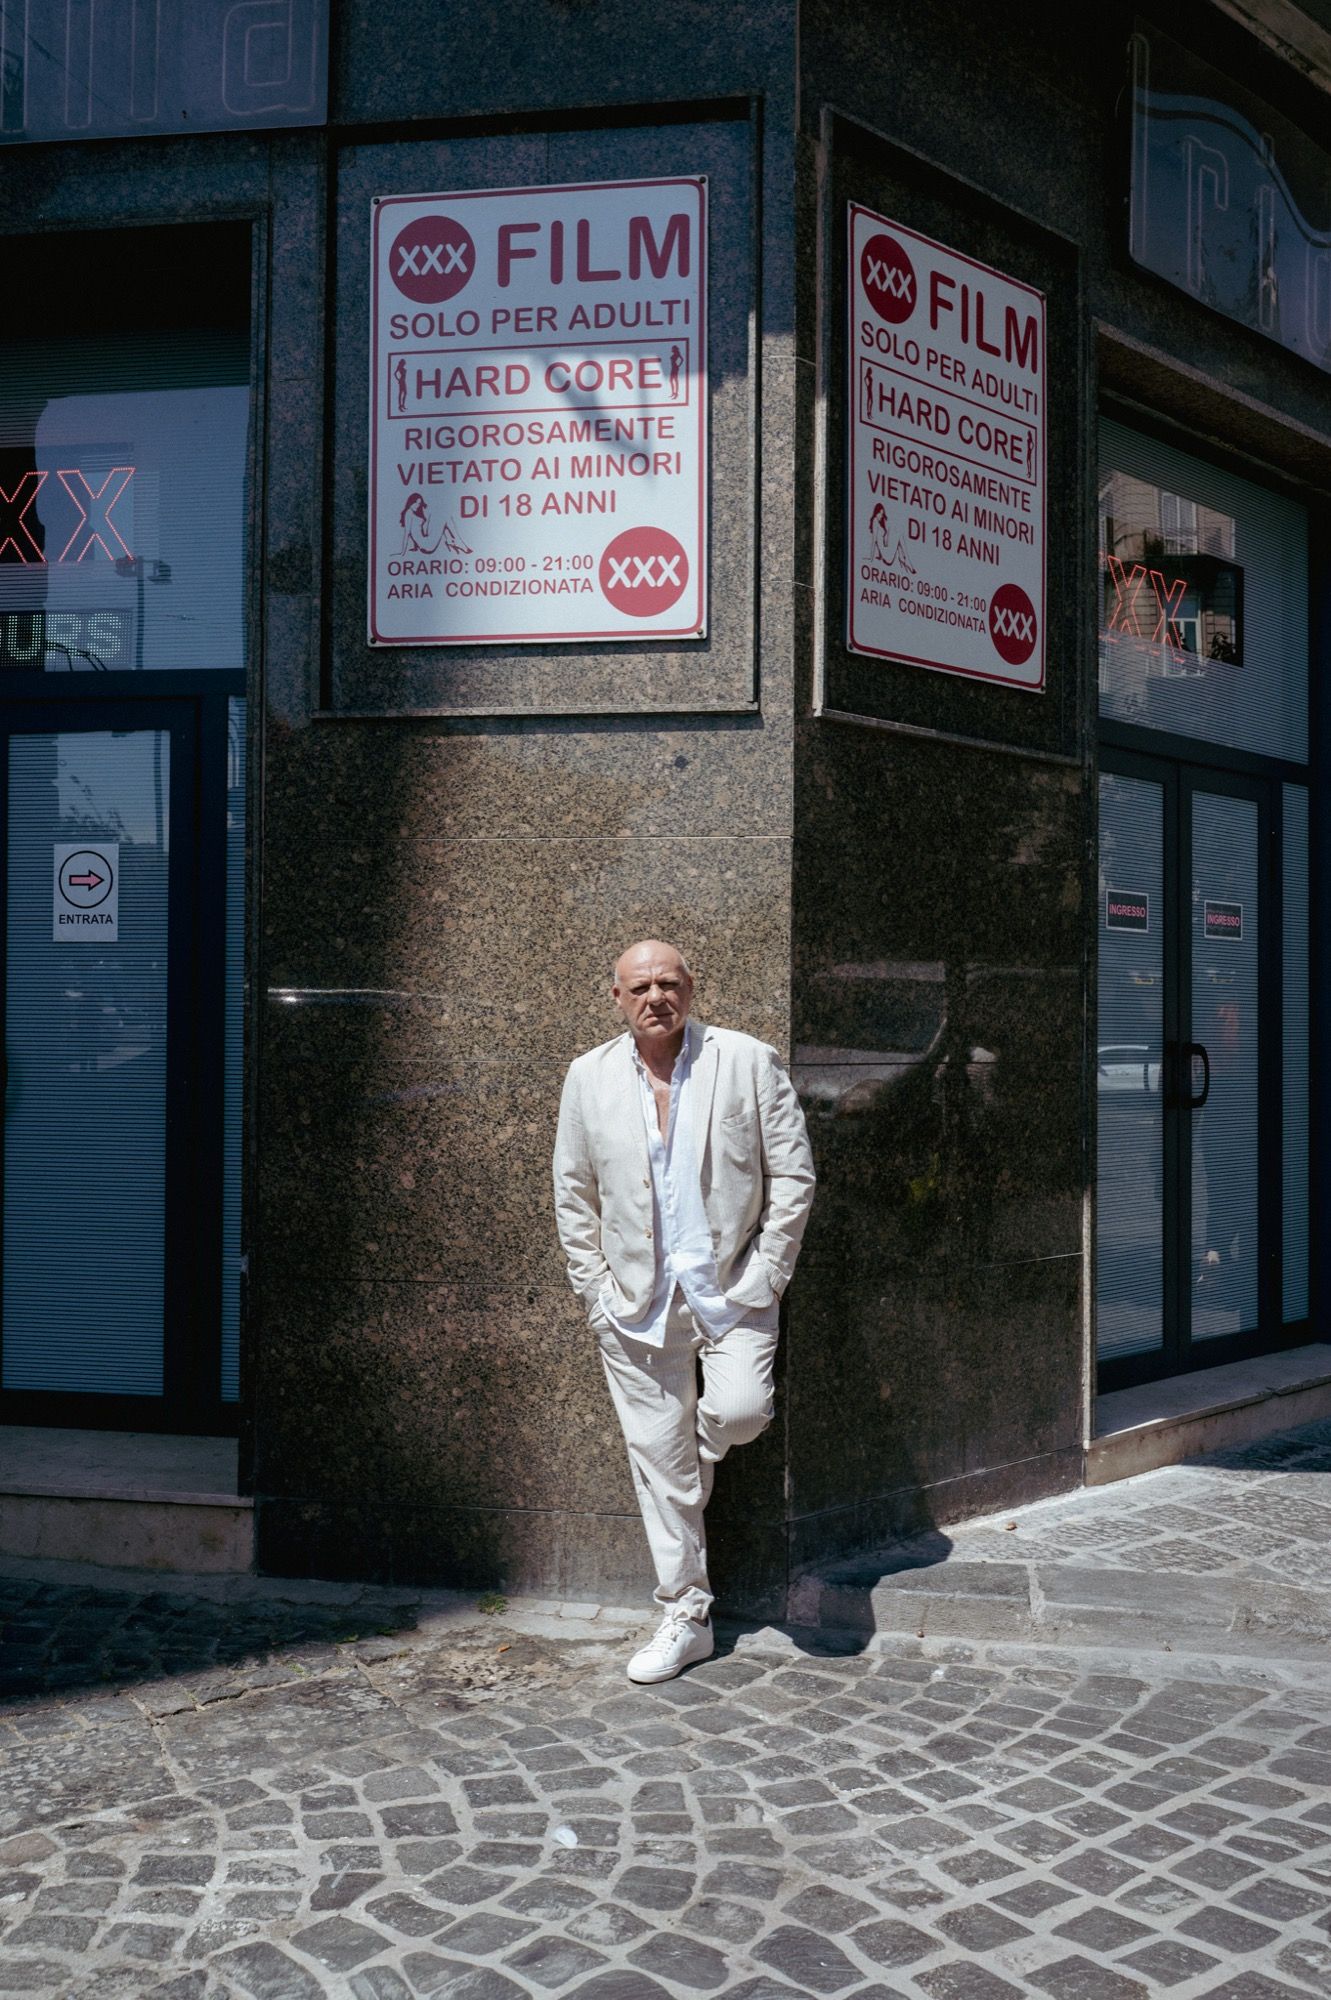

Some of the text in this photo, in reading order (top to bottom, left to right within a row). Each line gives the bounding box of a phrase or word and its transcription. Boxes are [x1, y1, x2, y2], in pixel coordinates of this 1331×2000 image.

[398, 242, 468, 277] XXX
[498, 213, 690, 288] FILM
[866, 255, 913, 304] XXX
[389, 299, 690, 340] SOLO PER ADULTI
[930, 270, 1037, 374] FILM
[416, 357, 662, 400] HARD CORE
[861, 320, 1038, 416] SOLO PER ADULTI
[405, 416, 675, 450] RIGOROSAMENTE
[879, 382, 1023, 465] HARD CORE
[397, 452, 681, 486] VIETATO AI MINORI
[873, 437, 1031, 513] RIGOROSAMENTE
[460, 490, 616, 519] DI 18 ANNI
[867, 469, 1034, 545] VIETATO AI MINORI
[908, 518, 999, 566] DI 18 ANNI
[388, 558, 469, 577] ORARIO:
[475, 557, 526, 574] 09:00
[543, 554, 594, 571] 21:00
[607, 555, 681, 589] XXX
[387, 578, 594, 599] ARIA CONDIZIONATA
[861, 564, 914, 592] ORARIO:
[917, 581, 948, 602] 09:00
[957, 592, 986, 613] 21:00
[860, 588, 986, 635] ARIA CONDIZIONATA
[993, 605, 1033, 644] XXX
[0, 613, 121, 661] URS
[58, 914, 113, 925] ENTRATA
[1109, 903, 1145, 918] INGRESSO
[1207, 914, 1240, 927] INGRESSO
